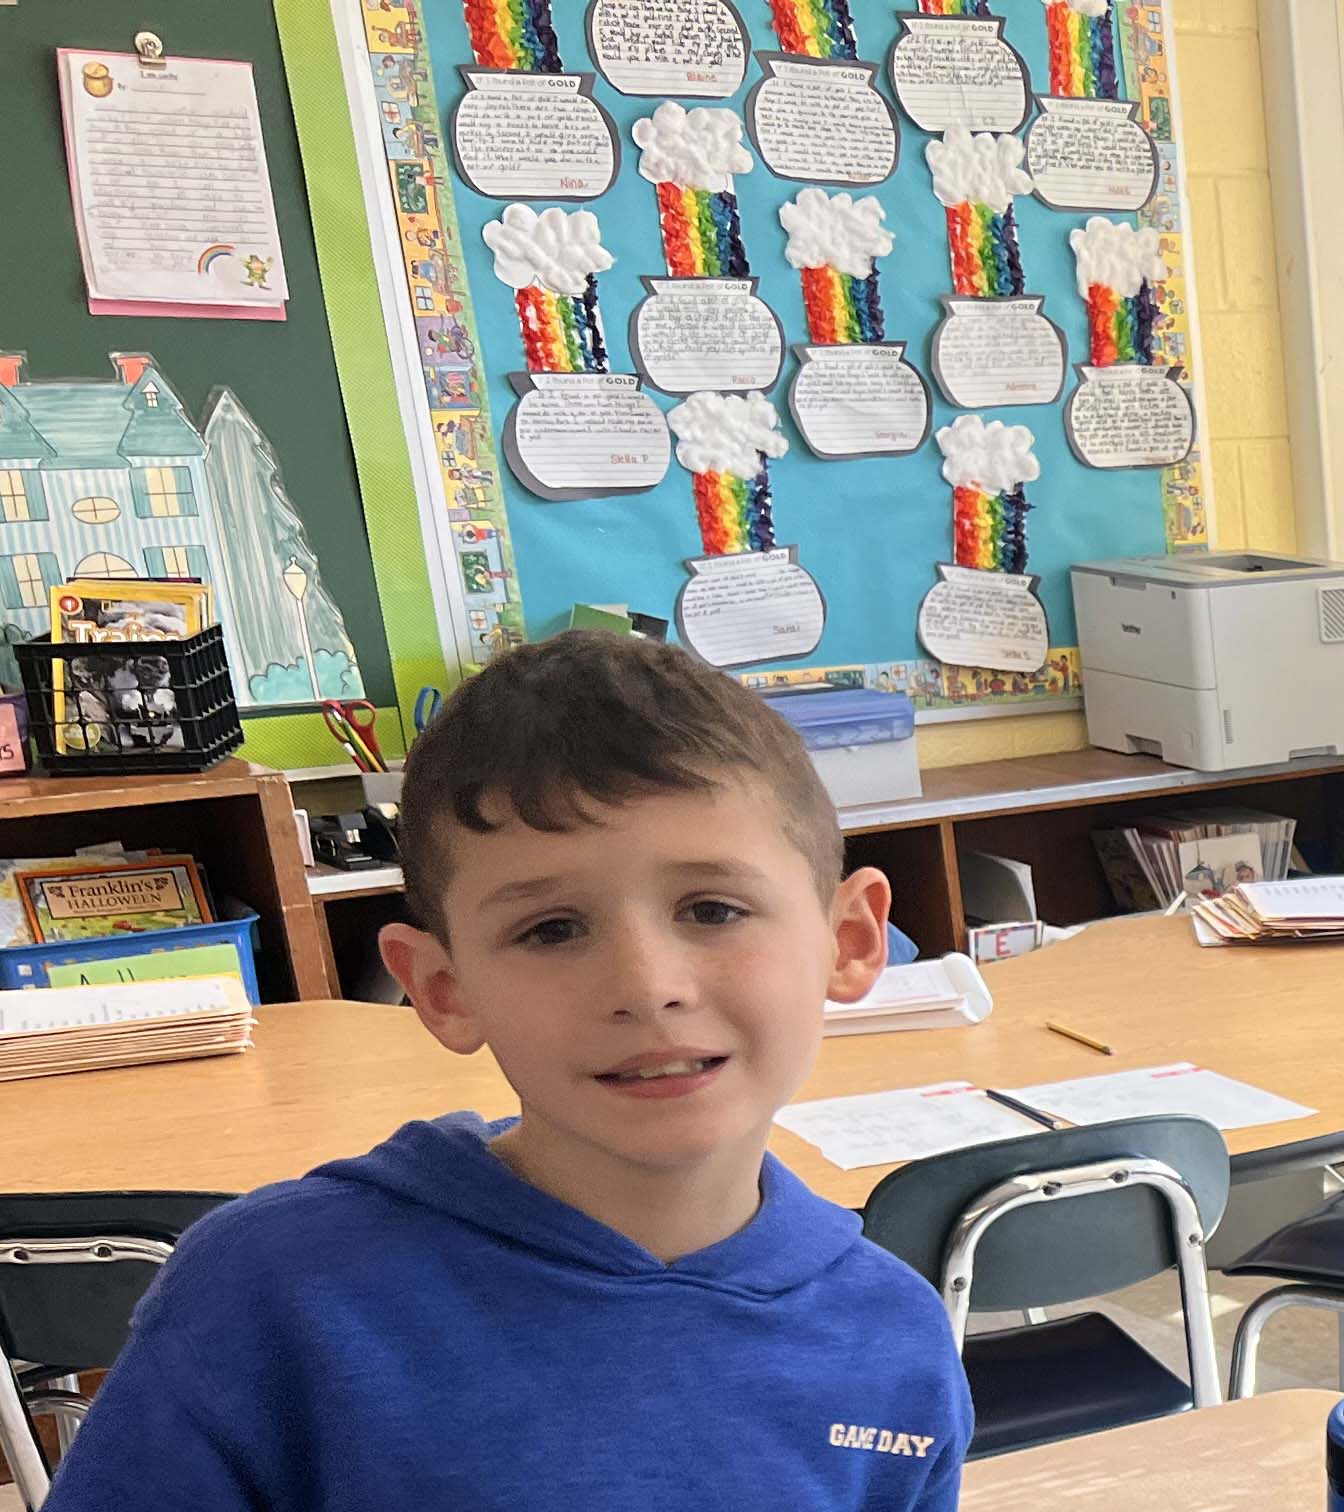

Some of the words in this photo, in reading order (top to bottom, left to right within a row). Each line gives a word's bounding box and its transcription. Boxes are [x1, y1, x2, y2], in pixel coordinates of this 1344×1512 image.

[841, 71, 865, 81] GOLD
[548, 79, 576, 88] GOLD
[606, 377, 635, 385] GOLD
[68, 878, 154, 899] Franklin's
[67, 892, 163, 911] HALLOWEEN
[829, 1423, 877, 1450] GAME
[877, 1429, 935, 1458] DAY
